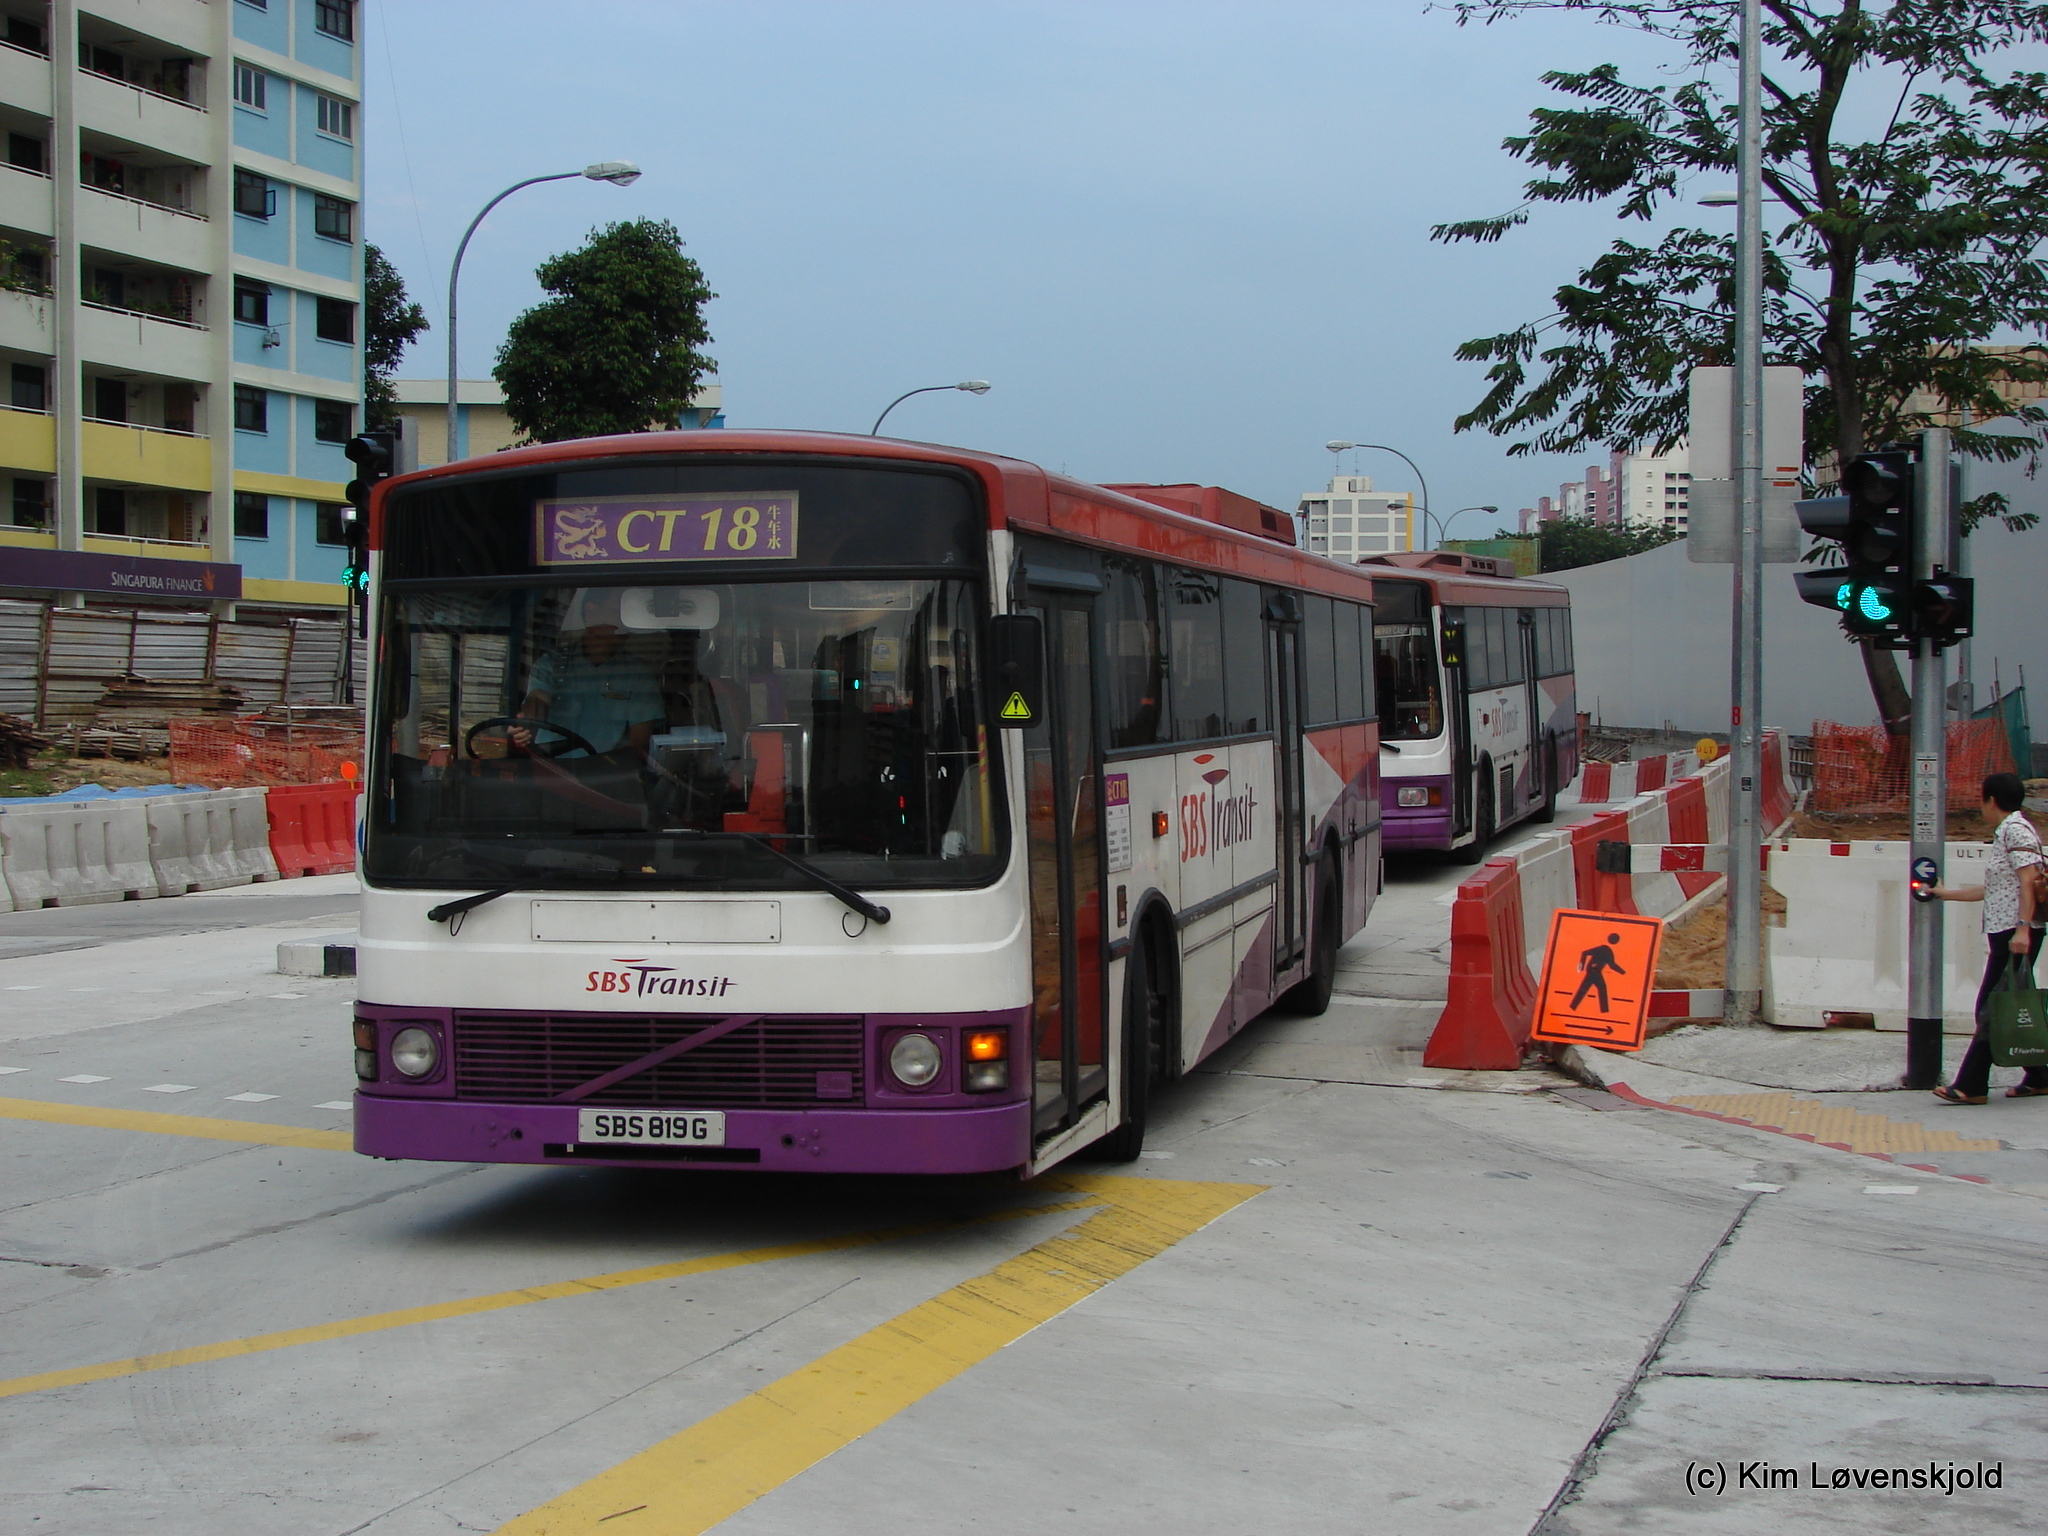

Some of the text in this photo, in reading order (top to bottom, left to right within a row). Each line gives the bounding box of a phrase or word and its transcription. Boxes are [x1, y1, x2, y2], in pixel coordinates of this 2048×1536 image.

[617, 506, 760, 553] CT 18
[111, 572, 203, 592] SINGAPURA FINANCE
[1181, 791, 1207, 863] SBS
[1202, 769, 1258, 868] Transit
[1956, 848, 1984, 858] ULT
[585, 966, 739, 999] SBS Transit
